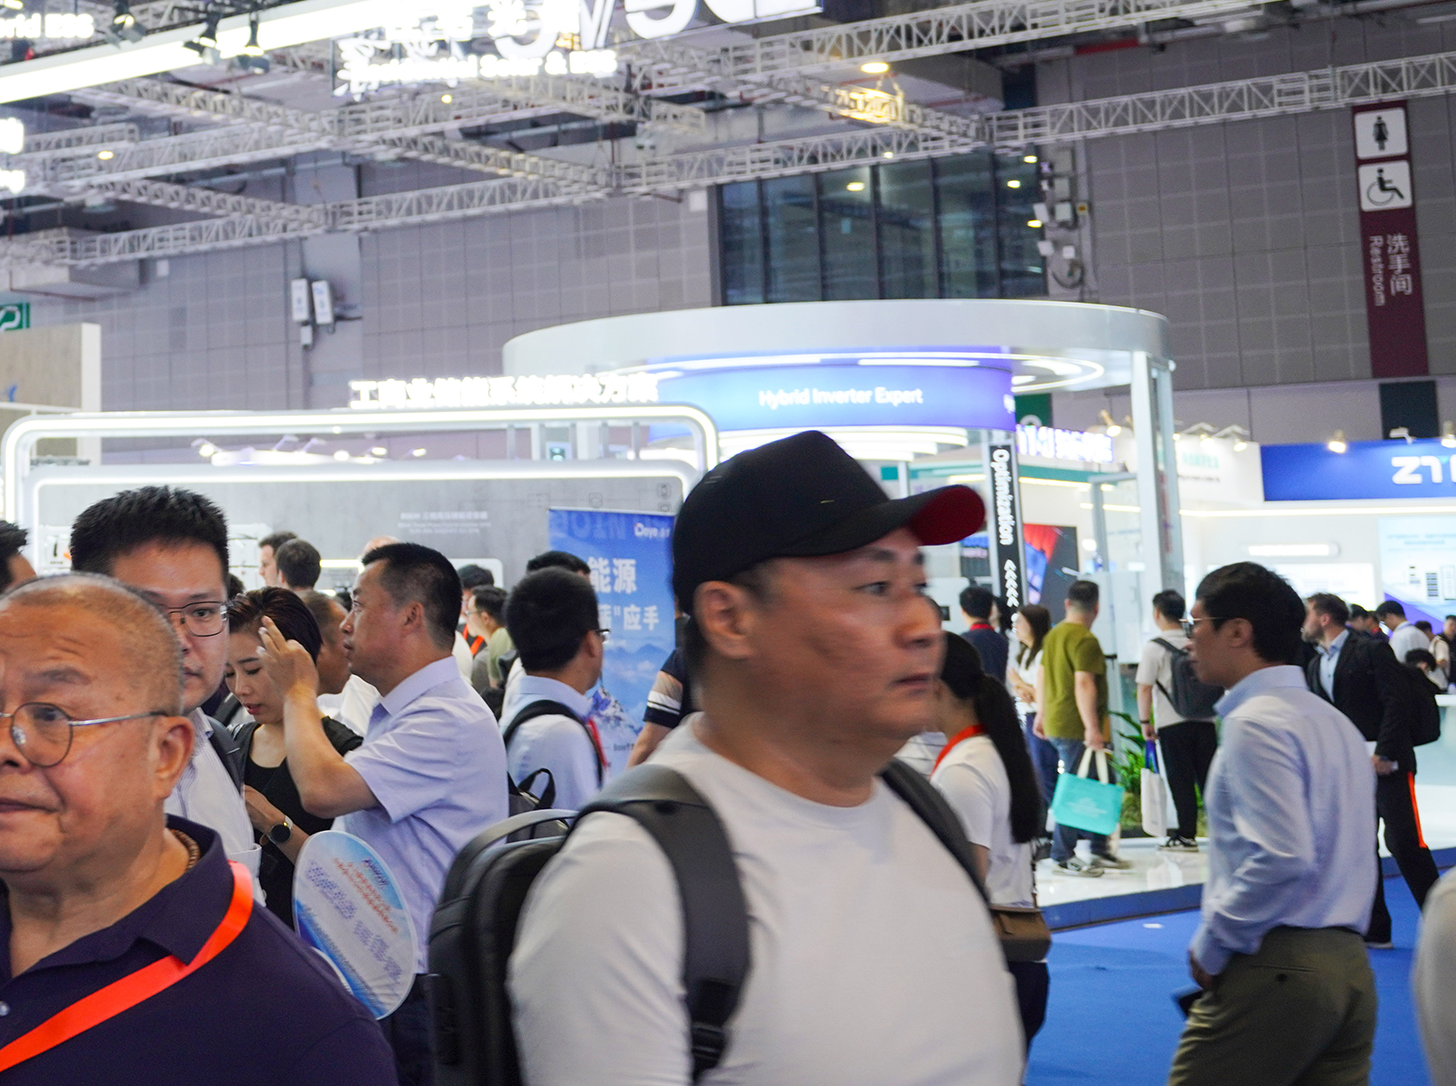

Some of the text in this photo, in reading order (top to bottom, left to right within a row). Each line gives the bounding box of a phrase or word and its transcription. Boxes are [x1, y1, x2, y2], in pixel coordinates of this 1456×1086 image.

[544, 51, 569, 75] &
[1369, 235, 1385, 307] Restroom
[1387, 233, 1412, 296] 洗手间
[759, 386, 924, 411] Hybrid Inverter Expert
[1391, 454, 1456, 485] ZT
[990, 448, 1014, 546] Optimization
